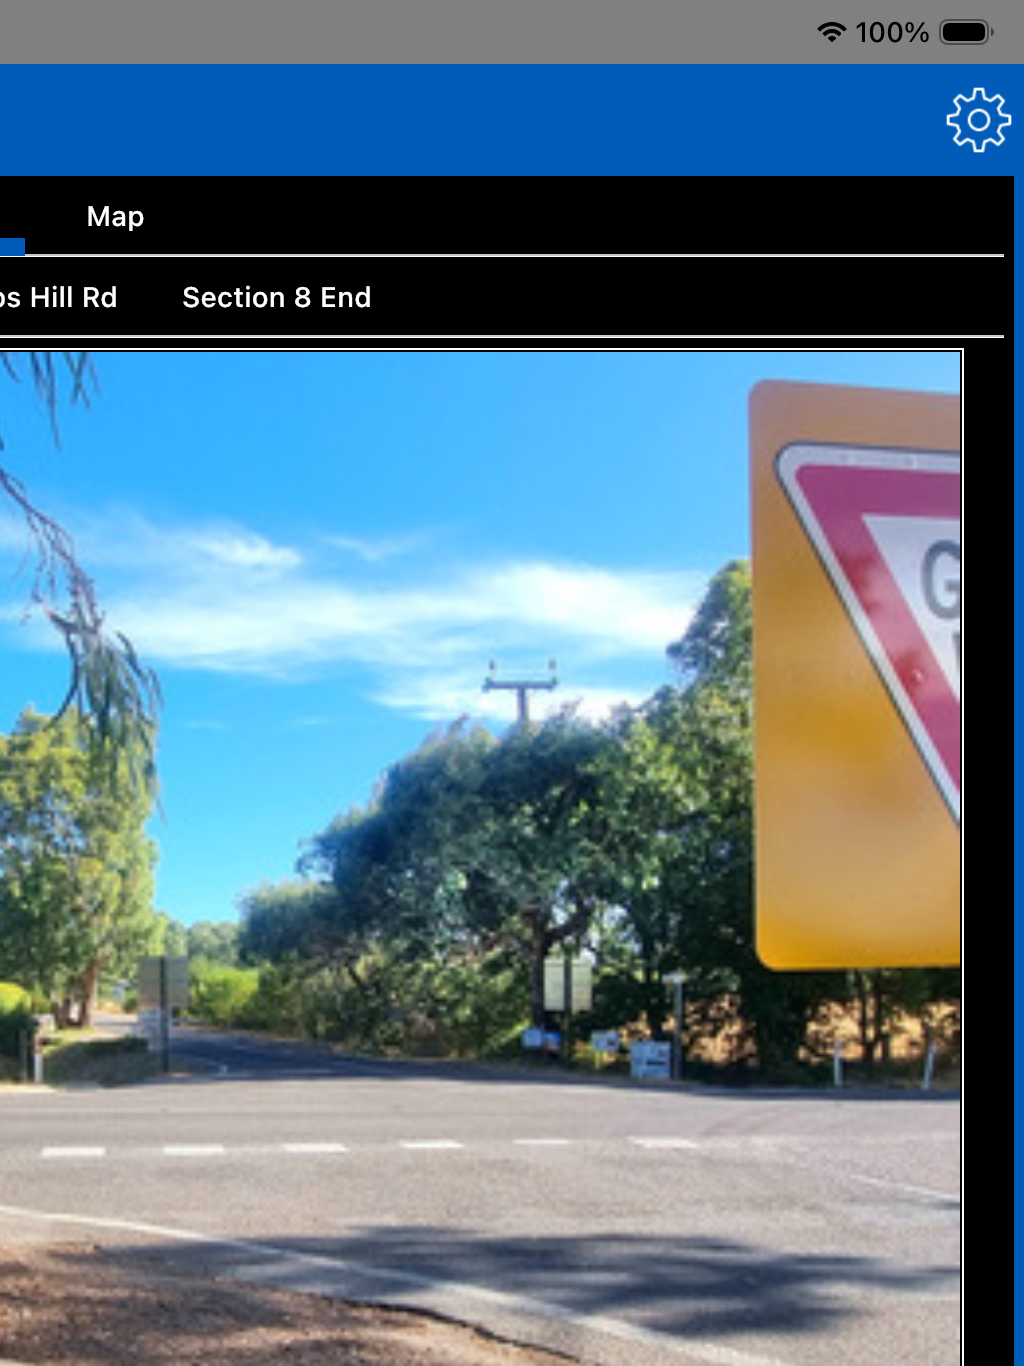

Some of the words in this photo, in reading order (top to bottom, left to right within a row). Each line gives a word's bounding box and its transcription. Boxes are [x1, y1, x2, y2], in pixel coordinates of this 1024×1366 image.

[856, 22, 929, 43] 100%
[88, 206, 144, 231] Map
[32, 286, 72, 308] Hill
[84, 286, 116, 308] Rd
[183, 285, 284, 308] Section
[295, 286, 311, 308] 8
[322, 286, 370, 308] End
